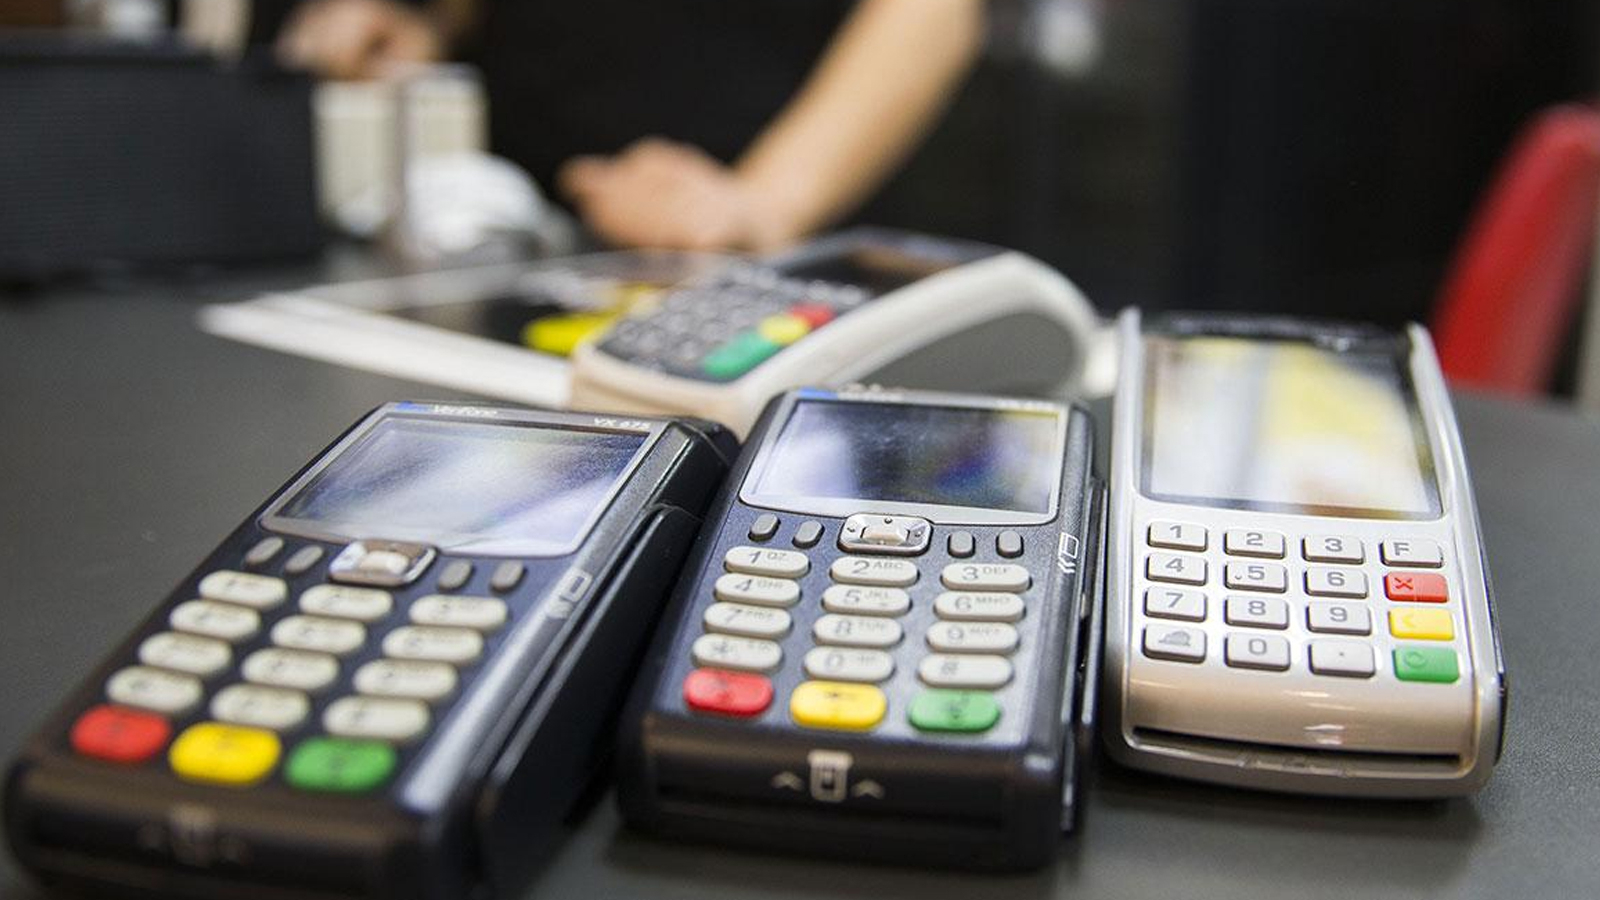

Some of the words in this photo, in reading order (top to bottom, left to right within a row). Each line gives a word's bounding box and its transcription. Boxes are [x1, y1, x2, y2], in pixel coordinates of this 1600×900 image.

[1169, 525, 1183, 539] 1
[1246, 532, 1264, 546] 2
[1325, 538, 1343, 552] 3
[1393, 541, 1410, 556] F
[748, 550, 762, 564] 1
[852, 560, 870, 575] 2
[872, 561, 904, 570] ABC
[961, 565, 979, 581] 3
[982, 565, 1012, 575] DEF
[1165, 558, 1185, 573] 4
[1247, 565, 1265, 581] 5
[735, 579, 752, 592] 4
[1327, 571, 1345, 587] 6
[844, 589, 862, 604] 5
[955, 595, 972, 611] 6
[1165, 591, 1184, 608] 7
[1248, 600, 1266, 616] 8
[1329, 606, 1348, 623] 9
[1248, 638, 1268, 656] 0
